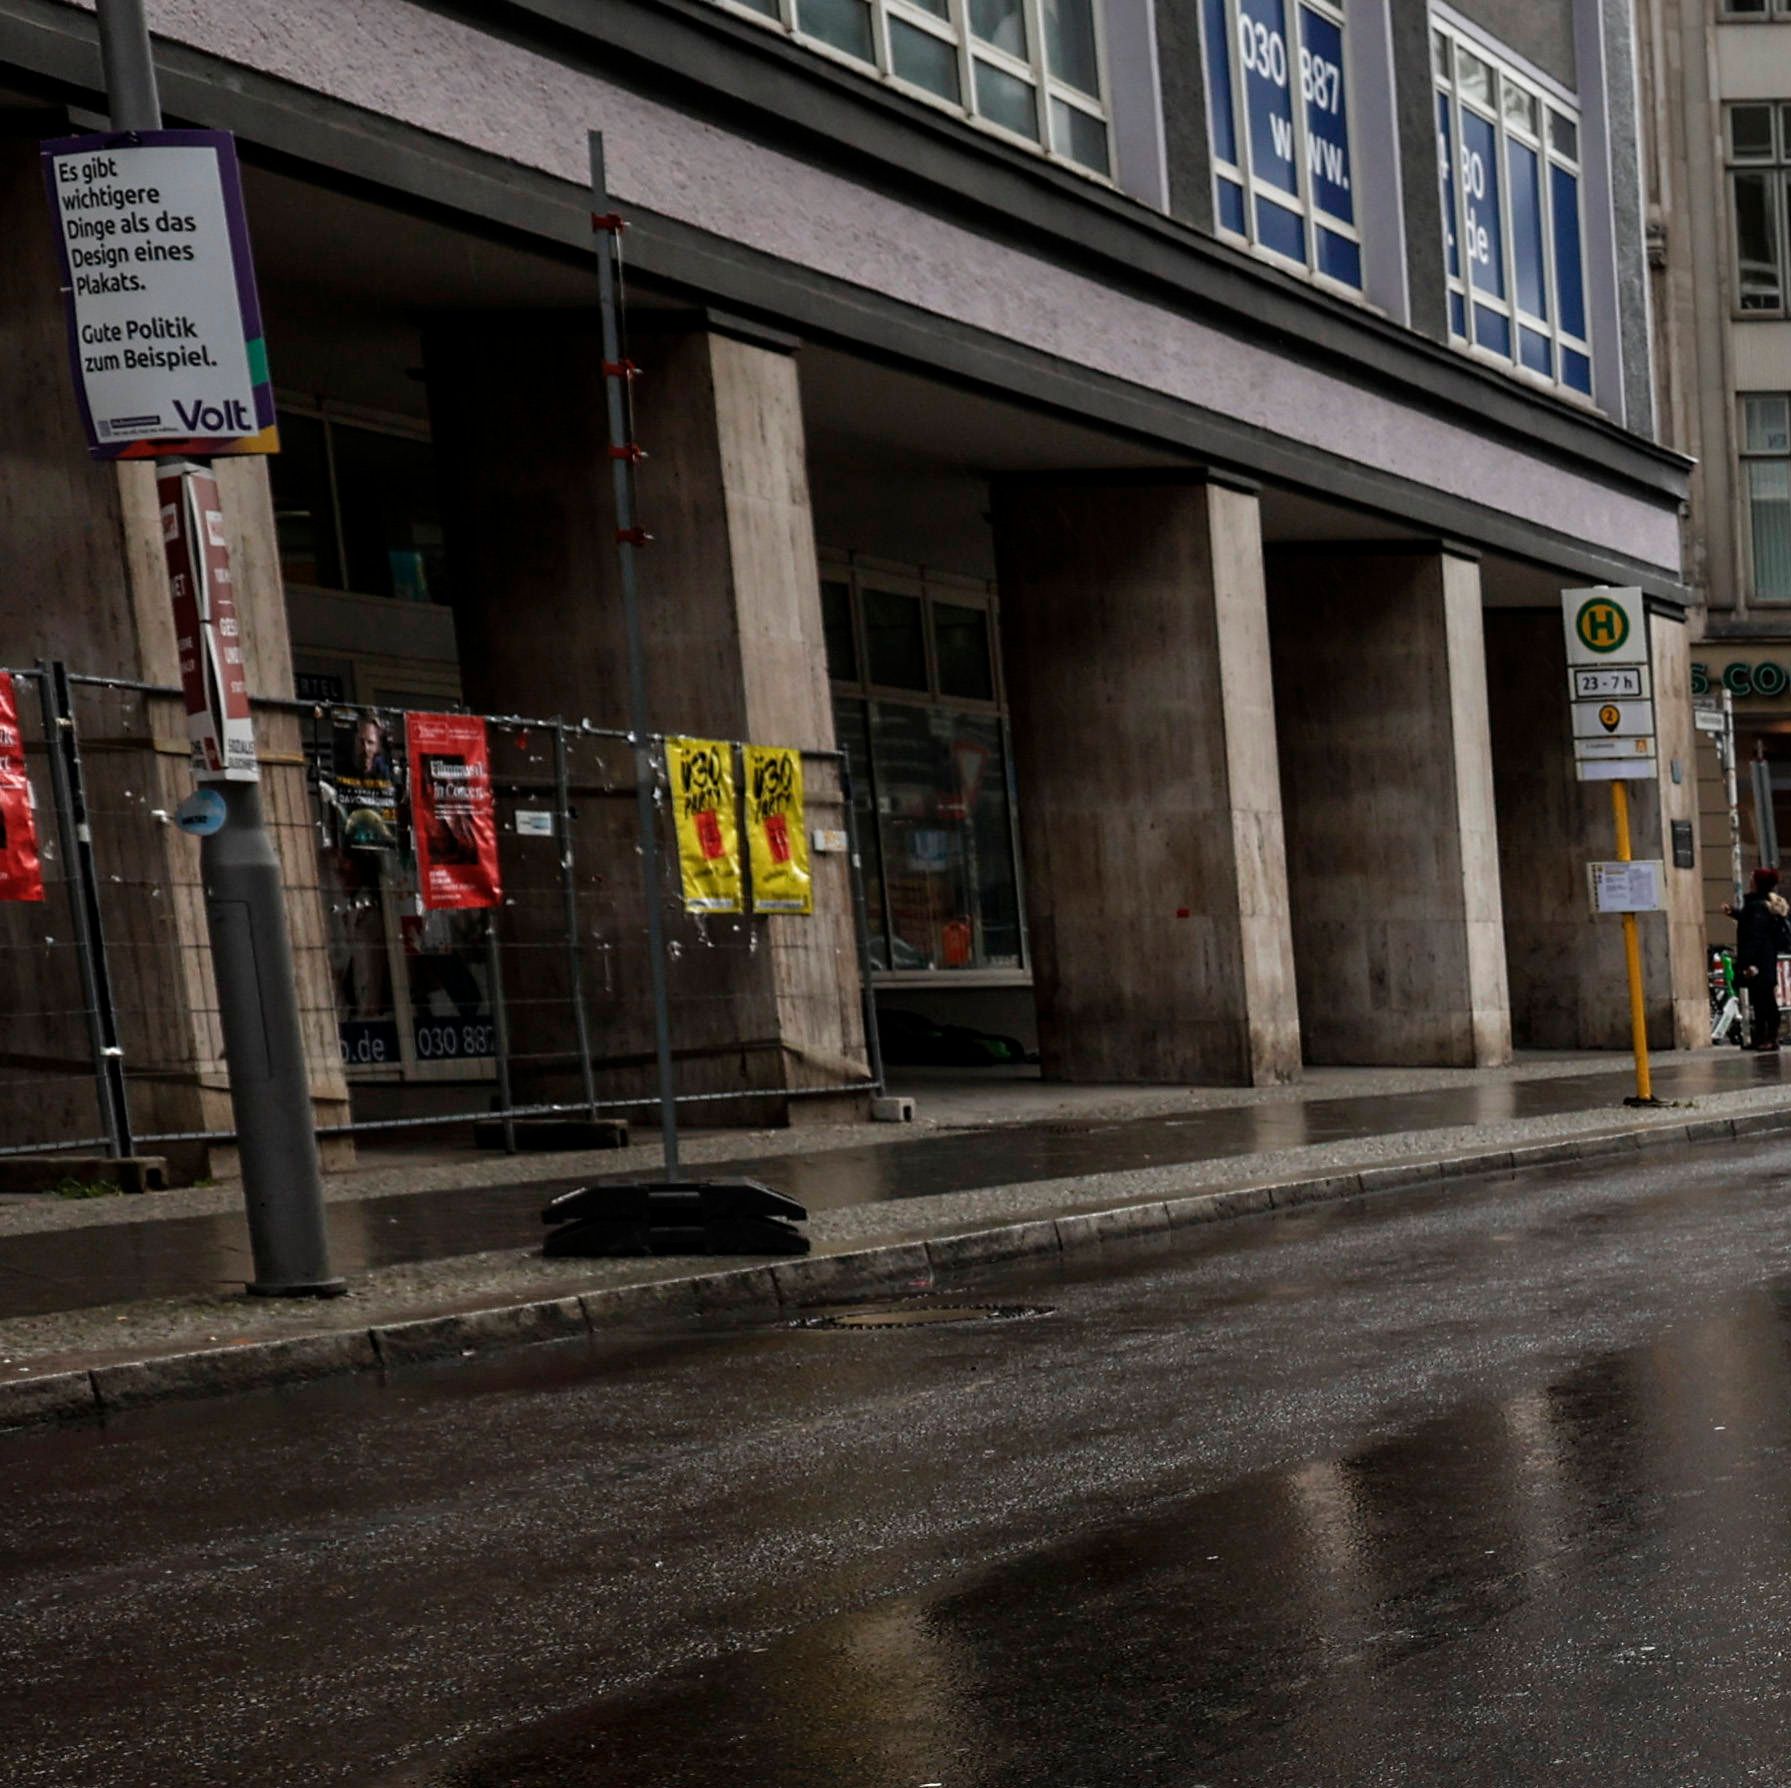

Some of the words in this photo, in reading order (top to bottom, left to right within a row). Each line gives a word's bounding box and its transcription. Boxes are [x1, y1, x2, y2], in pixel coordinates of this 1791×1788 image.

[1239, 13, 1286, 88] 030
[1300, 46, 1340, 115] 887
[59, 163, 78, 183] Es
[82, 157, 118, 185] gibt
[62, 185, 160, 211] wichtigere
[67, 216, 116, 242] Dinge
[121, 212, 150, 234] als
[156, 210, 197, 233] das
[72, 244, 130, 269] Design
[135, 240, 195, 263] eines
[76, 271, 147, 297] Plakats.
[82, 322, 122, 345] Gute
[126, 316, 198, 340] Politik
[85, 354, 121, 373] zum
[125, 345, 218, 372] Beispiel.
[172, 399, 253, 432] Volt
[1583, 675, 1598, 690] 23
[1611, 676, 1619, 689] 7
[1624, 675, 1633, 689] h
[418, 1027, 456, 1056] 030
